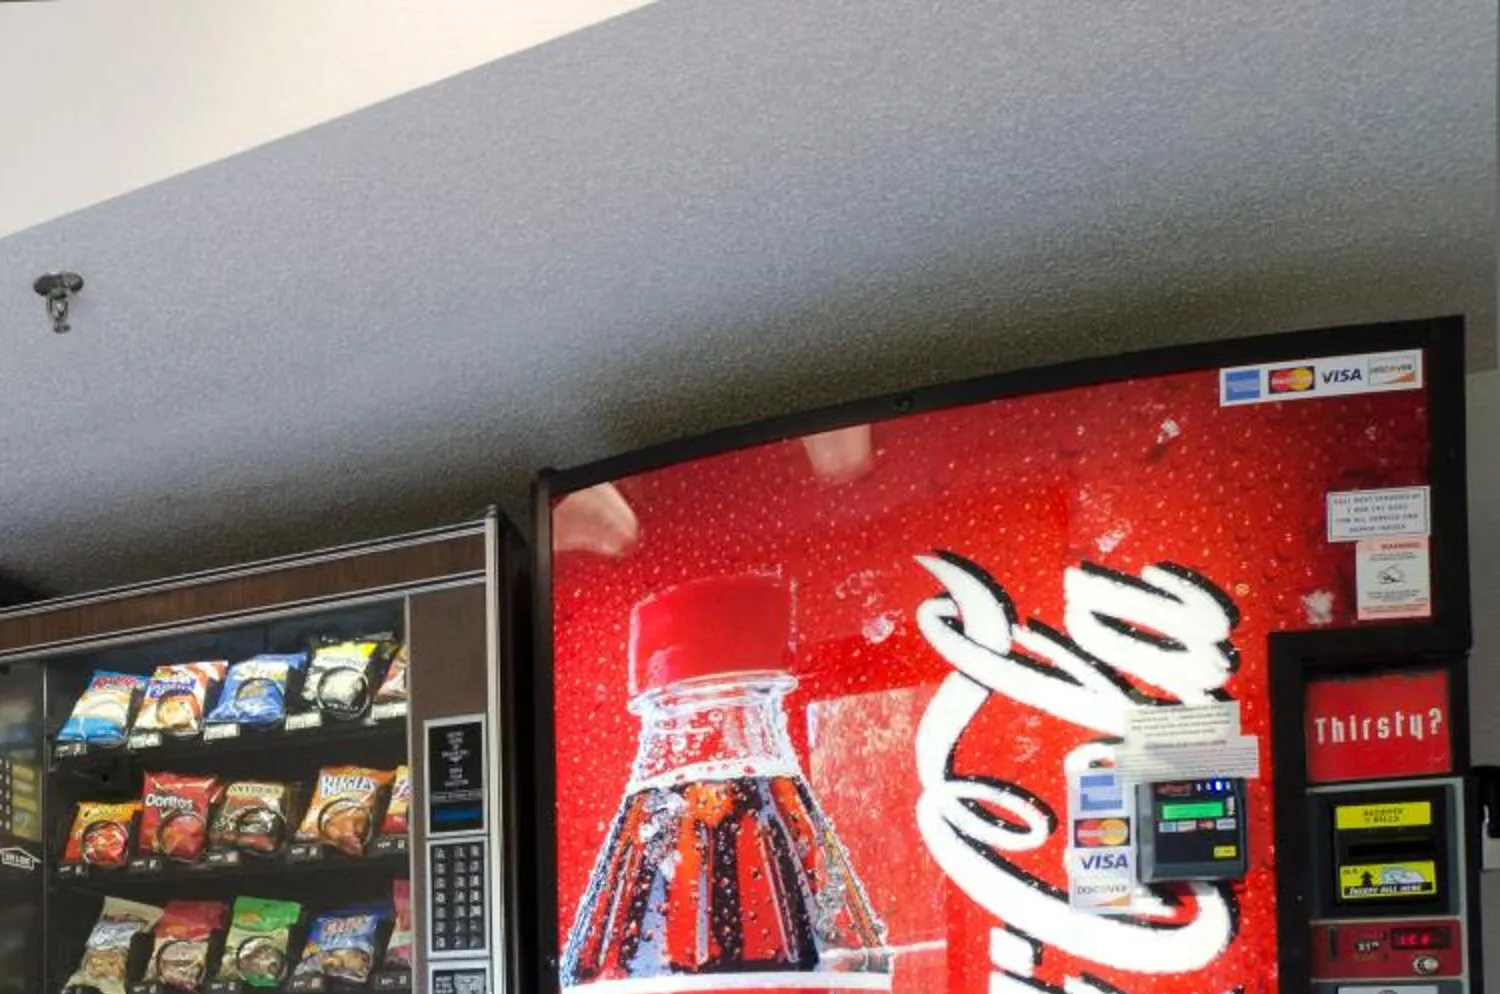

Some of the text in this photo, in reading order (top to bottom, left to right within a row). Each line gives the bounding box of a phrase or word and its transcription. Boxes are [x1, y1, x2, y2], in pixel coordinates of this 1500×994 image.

[1321, 367, 1364, 385] VISA
[1313, 706, 1444, 747] Thirsty?
[144, 792, 194, 811] Doritos
[1080, 852, 1129, 871] VISA
